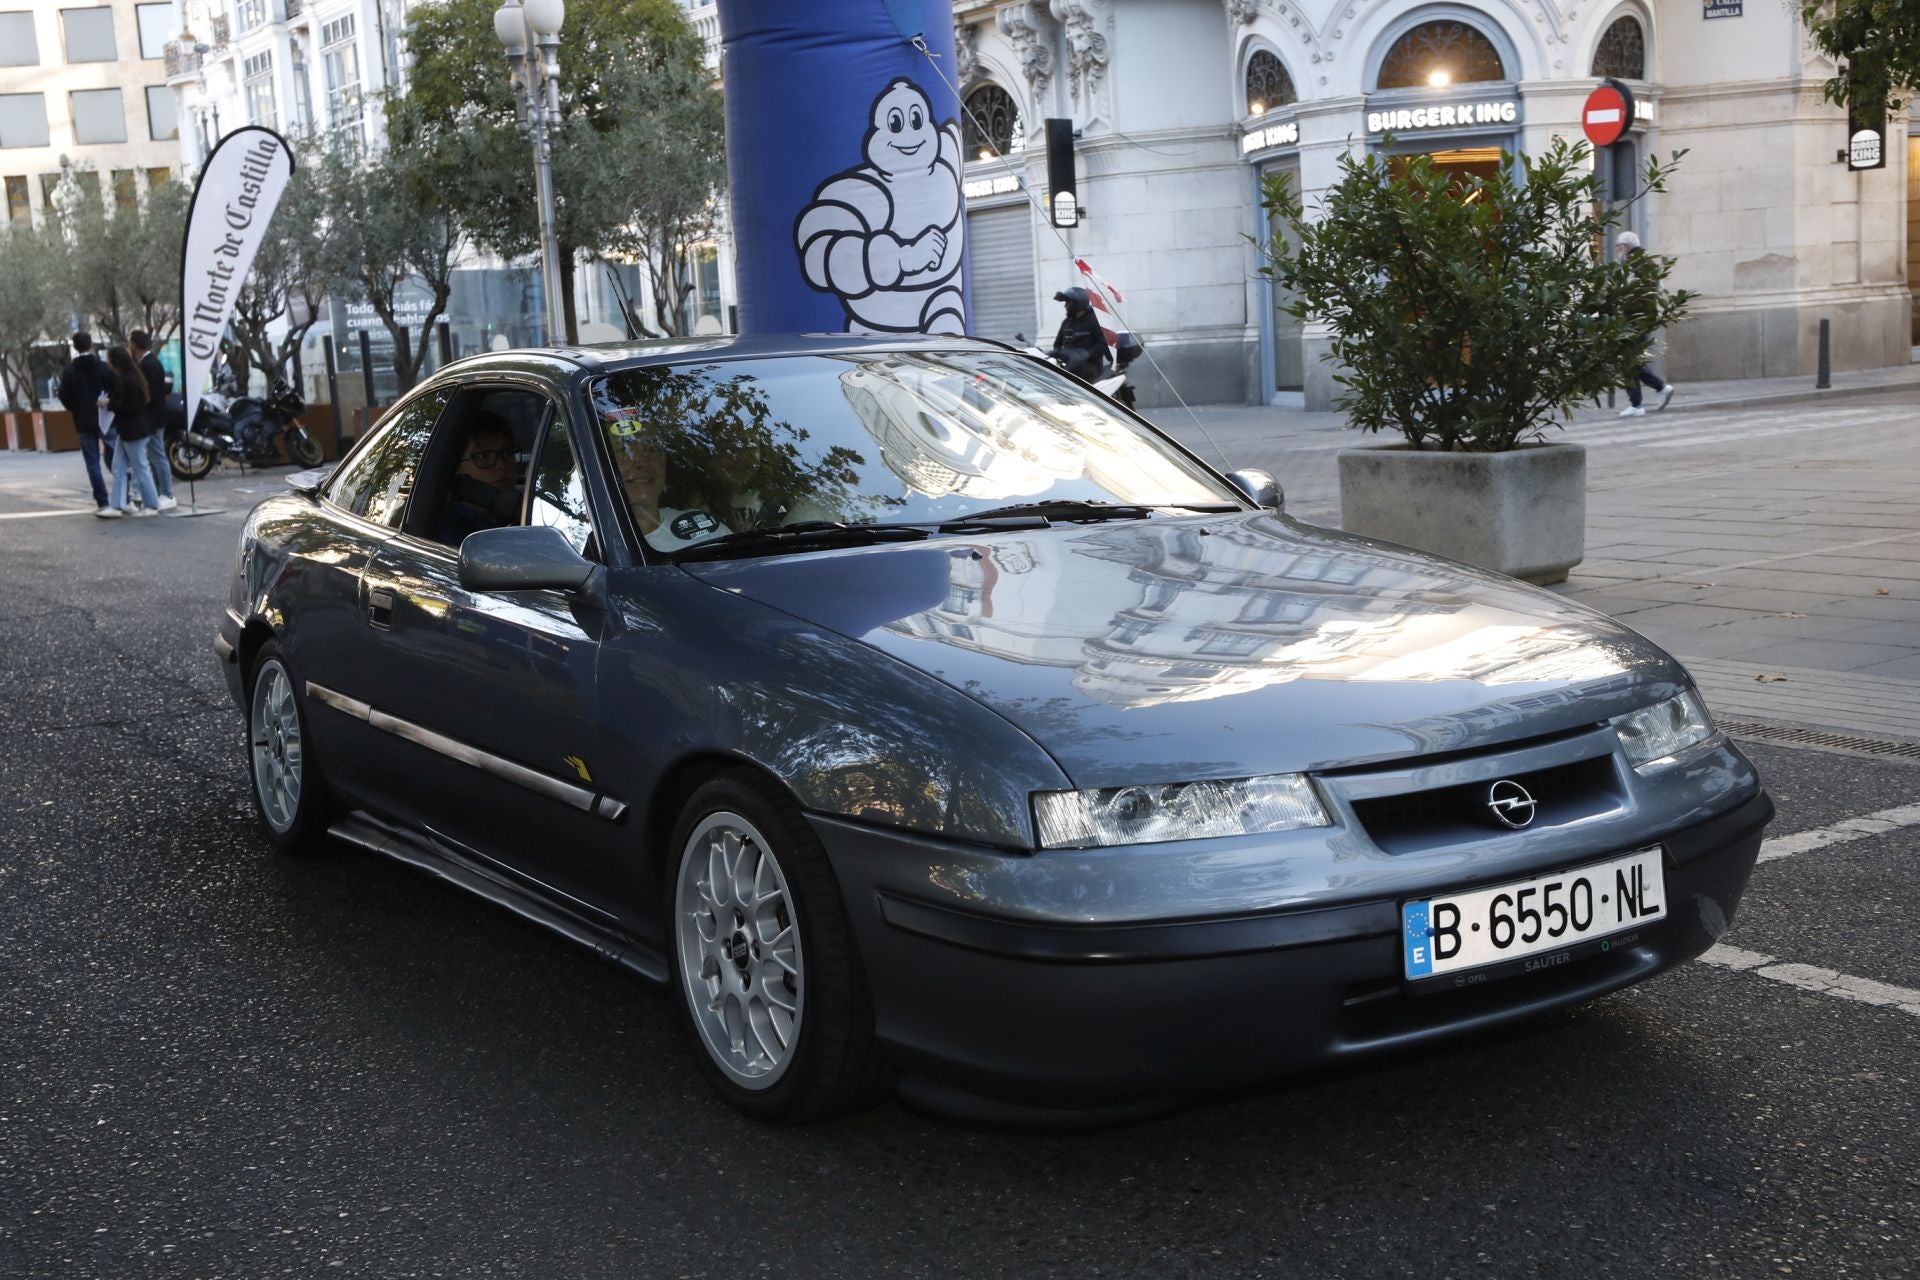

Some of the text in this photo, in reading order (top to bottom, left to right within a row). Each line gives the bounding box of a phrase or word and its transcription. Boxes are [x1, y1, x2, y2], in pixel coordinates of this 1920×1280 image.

[1706, 7, 1740, 17] MANTILLA
[1368, 102, 1516, 132] BURGER KING
[1265, 123, 1298, 146] KING
[1851, 148, 1880, 161] KING
[1055, 208, 1076, 219] KING
[188, 138, 280, 361] El Norte de Castilla
[345, 303, 375, 315] Todo
[393, 313, 450, 325] hablaos
[1413, 947, 1425, 964] E
[1524, 952, 1571, 973] SAUTER
[1468, 974, 1488, 984] OPEL
